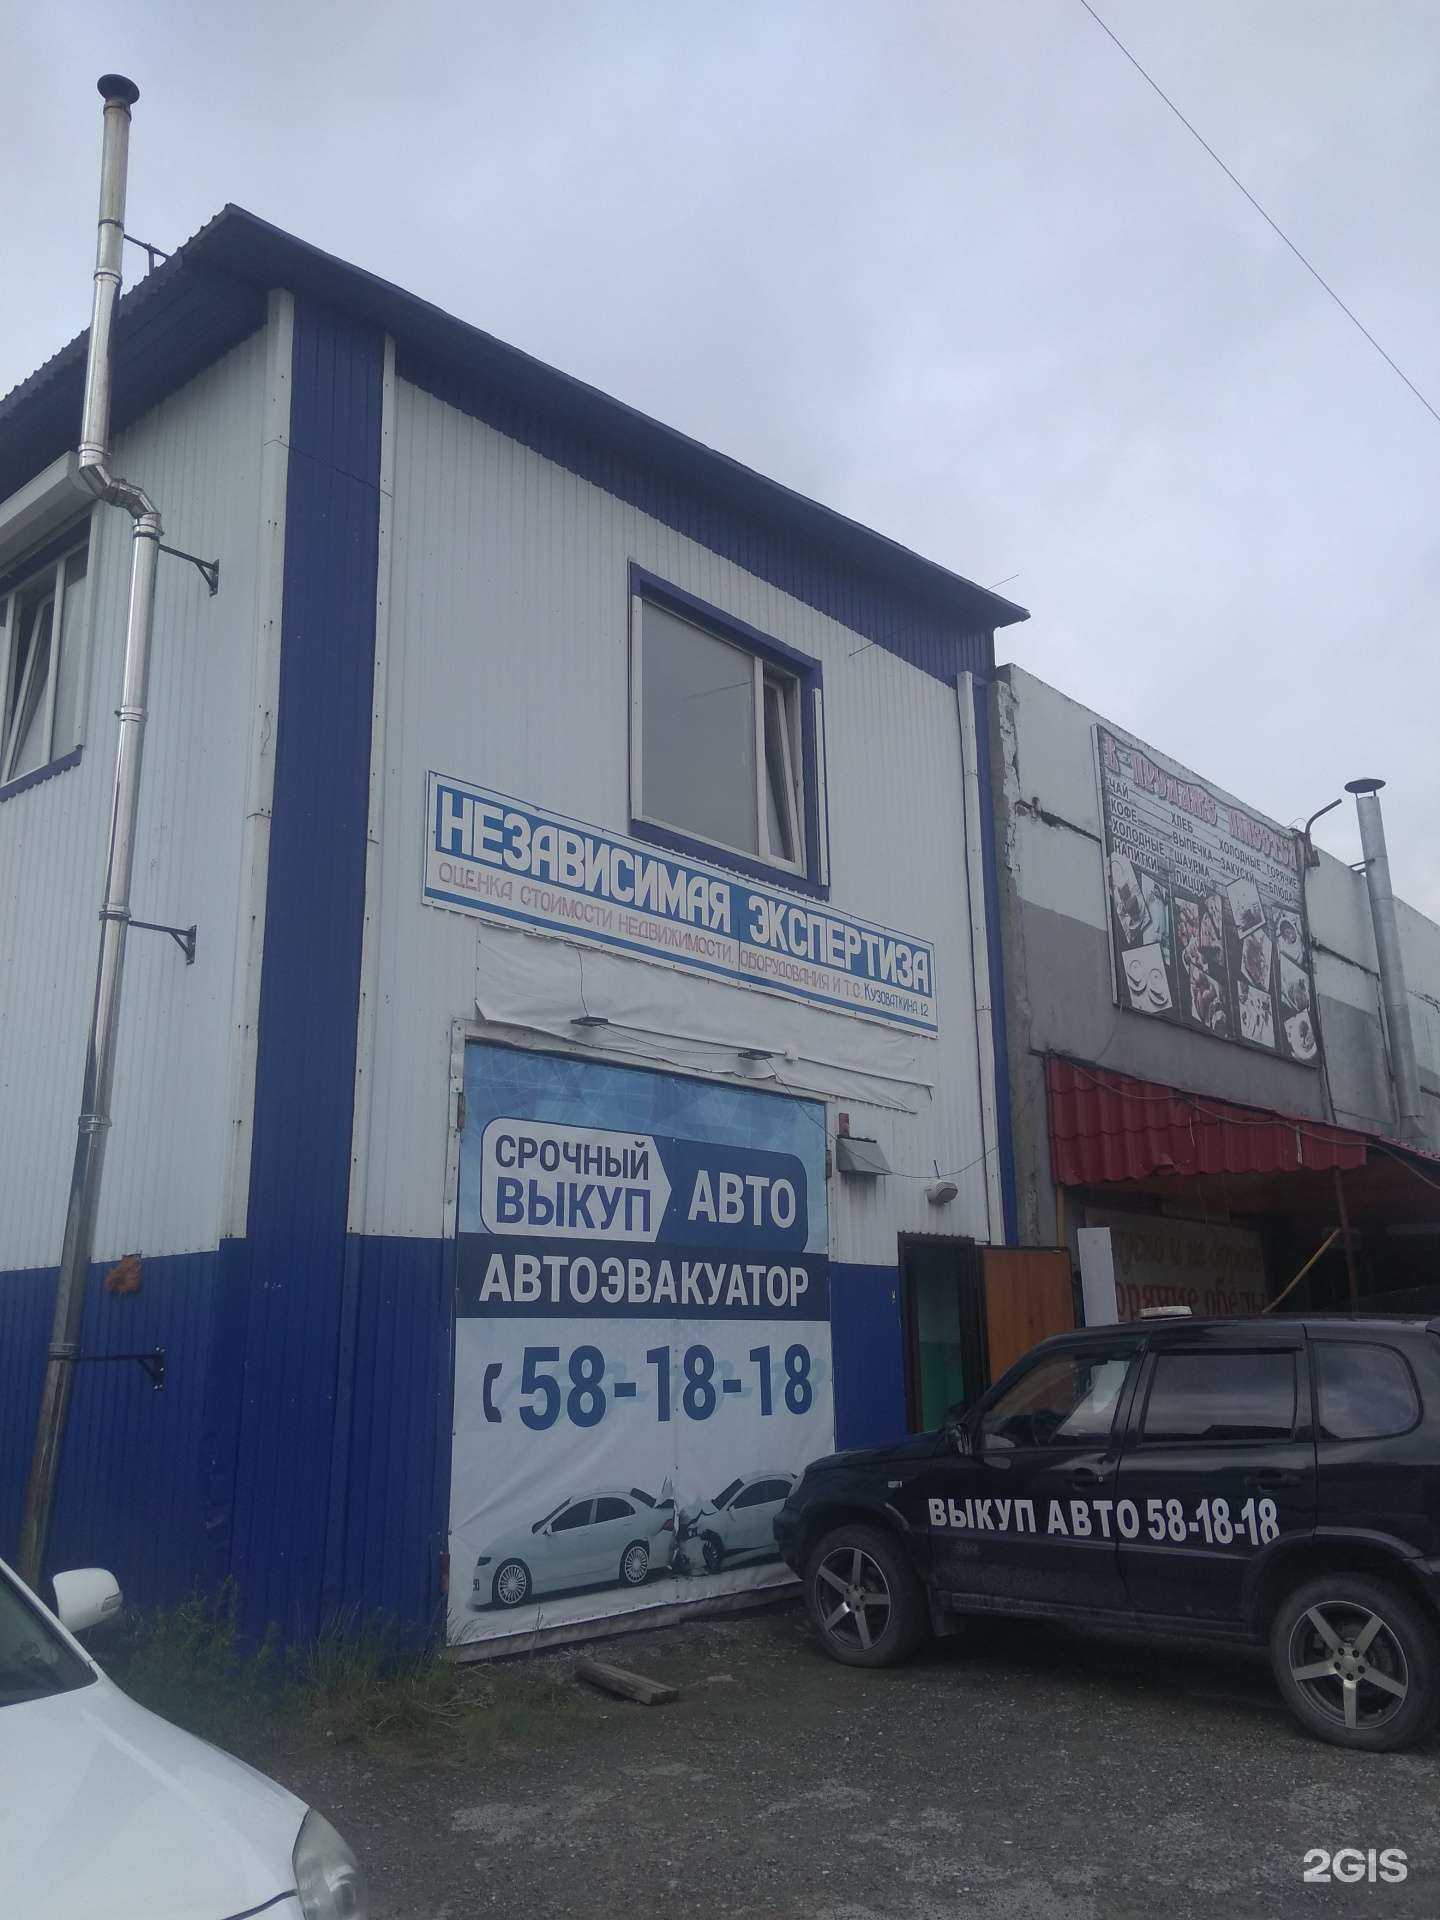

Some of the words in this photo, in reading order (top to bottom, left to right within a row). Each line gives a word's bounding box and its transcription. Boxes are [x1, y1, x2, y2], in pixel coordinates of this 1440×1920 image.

[1109, 777, 1129, 800] ЧАЙ
[1110, 799, 1138, 823] КОФЕ
[1170, 811, 1193, 833] ХЛЕБ
[1112, 818, 1165, 855] ХОЛОДНЫЕ
[1172, 832, 1213, 862] ВЫПЕЧКА
[1175, 850, 1210, 877] ШАУРМА
[1219, 840, 1262, 871] ХОЛОДНЫЕ
[441, 791, 731, 934] НЕЗАВИСИМАЯ
[748, 895, 929, 994] ЭКСПЕРТИЗА
[438, 862, 513, 901] ОЦЕНКА
[520, 886, 613, 925] СТОИМОСТИ
[741, 950, 830, 994] ОБОРУДОВАНИЯ
[833, 978, 841, 994] И
[920, 1001, 929, 1017] 12
[495, 1134, 649, 1181] СРОЧНЫЙ
[496, 1176, 652, 1233] ВЫКУП
[687, 1169, 796, 1229] АВТО
[479, 1253, 809, 1307] АВТОЭВАКУАТОР
[519, 1344, 812, 1431] 58-18-18
[928, 1498, 1036, 1533] ВЫКУП
[1047, 1499, 1140, 1538] АВТО
[1147, 1498, 1281, 1546] 58-18-18
